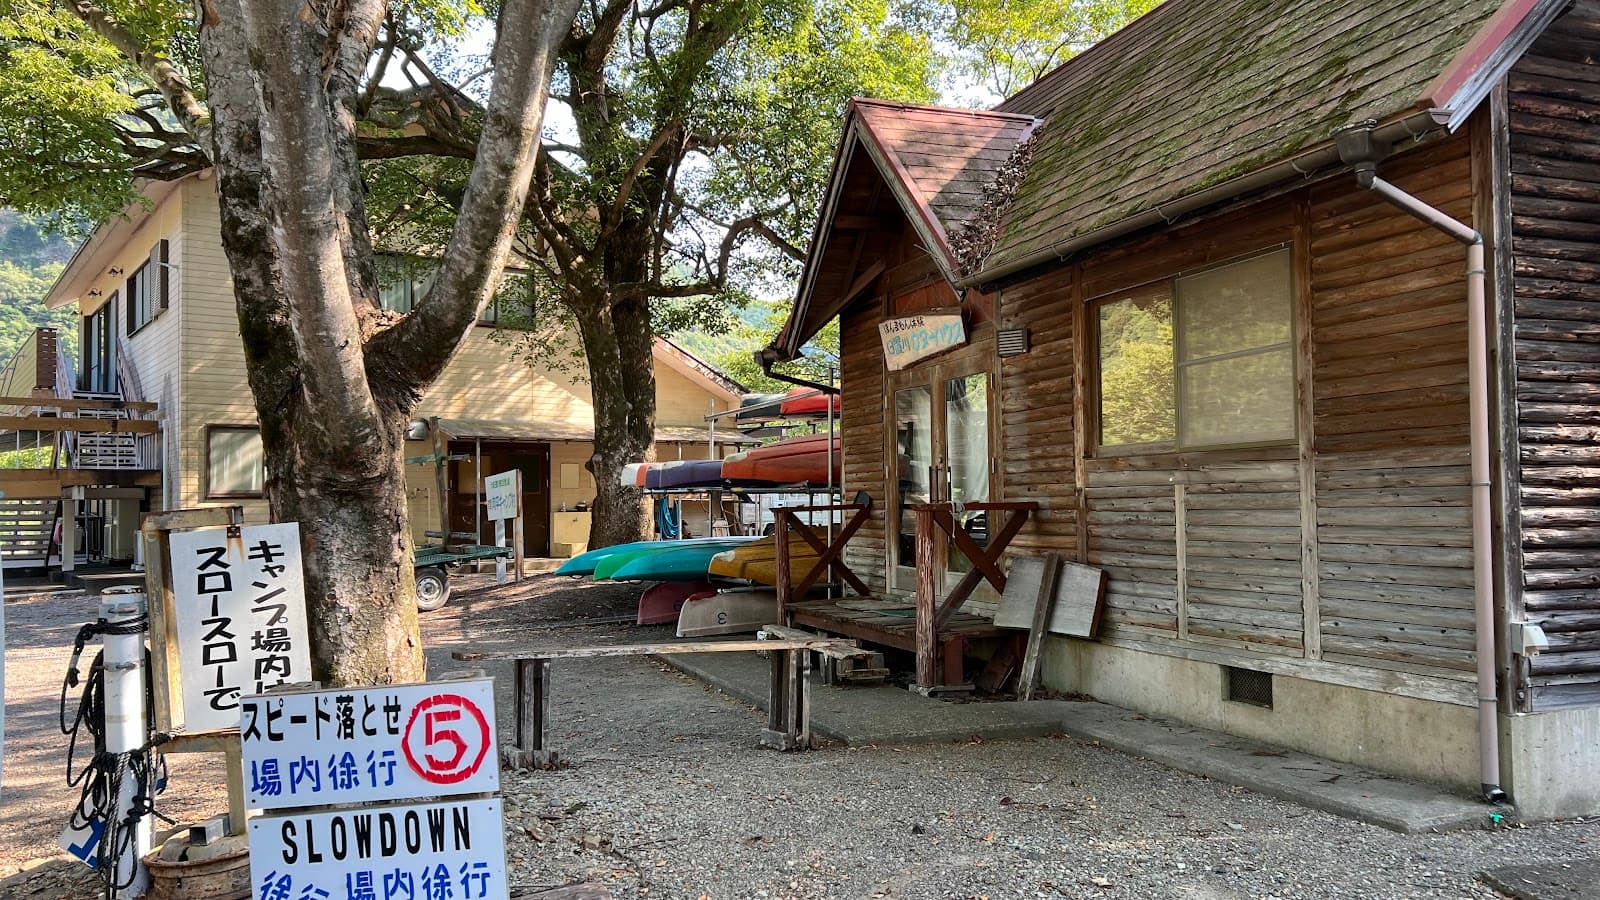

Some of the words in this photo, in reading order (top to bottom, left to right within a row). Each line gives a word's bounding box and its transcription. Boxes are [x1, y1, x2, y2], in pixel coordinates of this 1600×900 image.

[196, 546, 241, 711] スロースローで
[242, 694, 401, 742] スピード落とせ
[251, 749, 398, 797] 場内徐行
[281, 806, 471, 865] SLOWDOWN
[346, 862, 491, 900] 場内徐行
